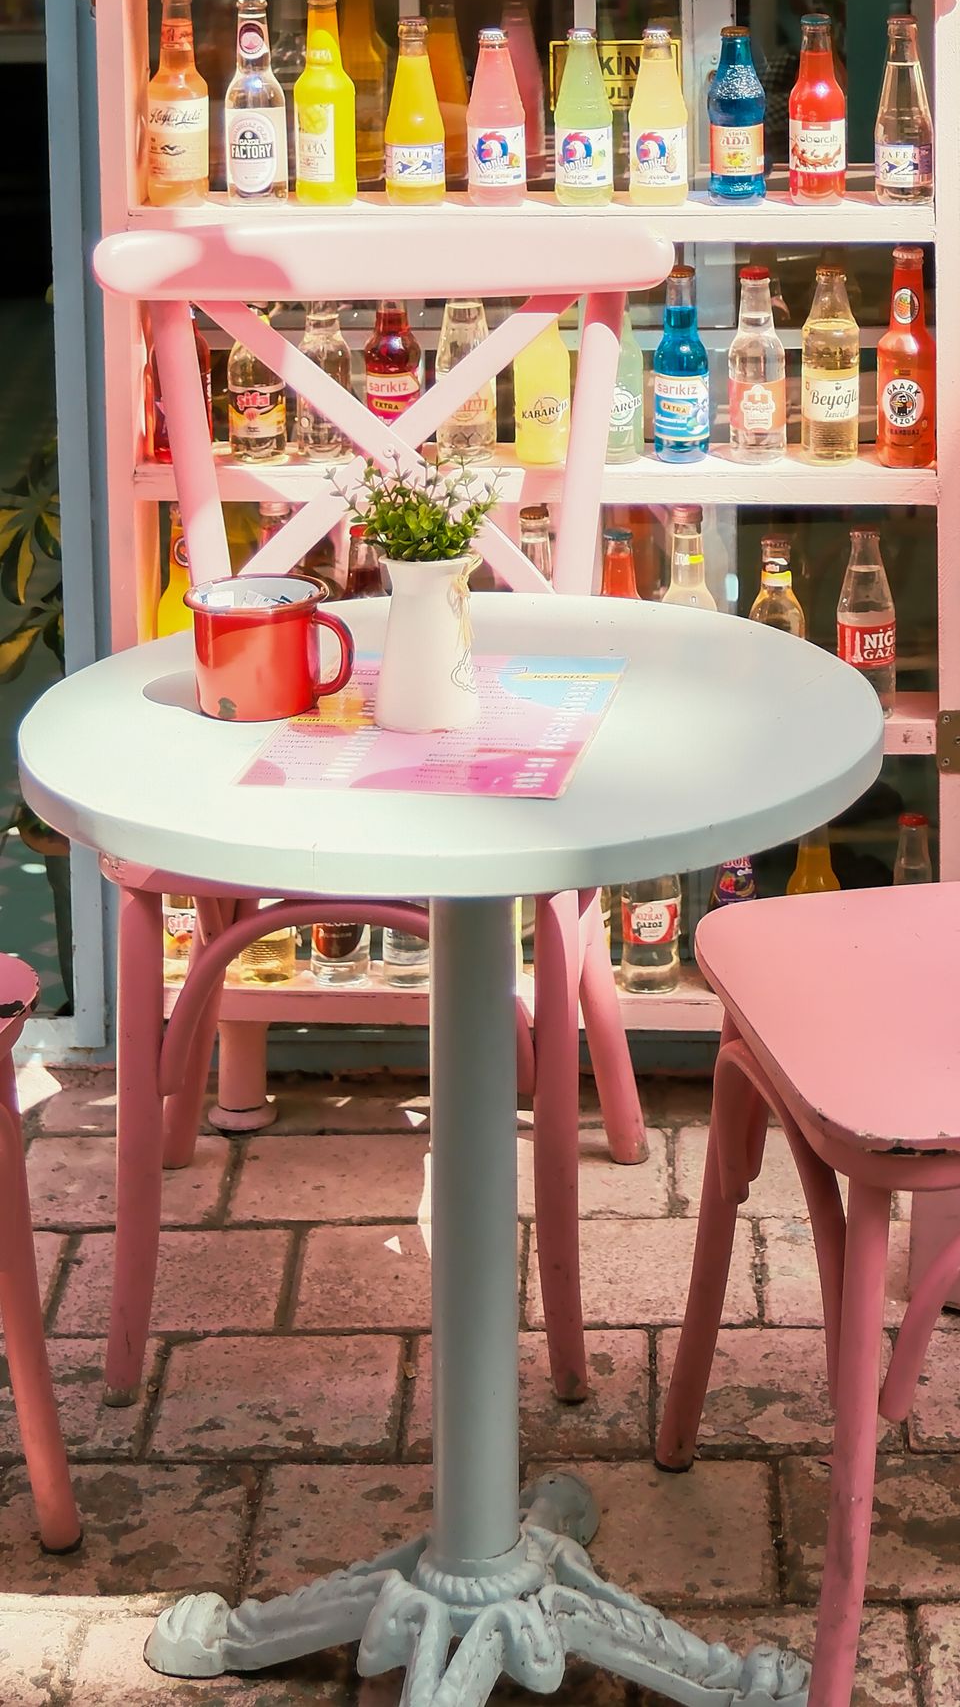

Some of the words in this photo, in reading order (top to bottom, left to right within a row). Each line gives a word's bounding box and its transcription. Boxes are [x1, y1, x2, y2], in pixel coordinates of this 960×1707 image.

[230, 143, 273, 159] FACTORY
[881, 152, 917, 161] ZAFER
[368, 380, 409, 394] sarıkız
[656, 381, 698, 396] sarıkız
[886, 382, 922, 397] GAARK
[374, 400, 400, 411] EXTRA
[662, 401, 687, 414] EXTRA
[888, 413, 918, 426] GAZOZ
